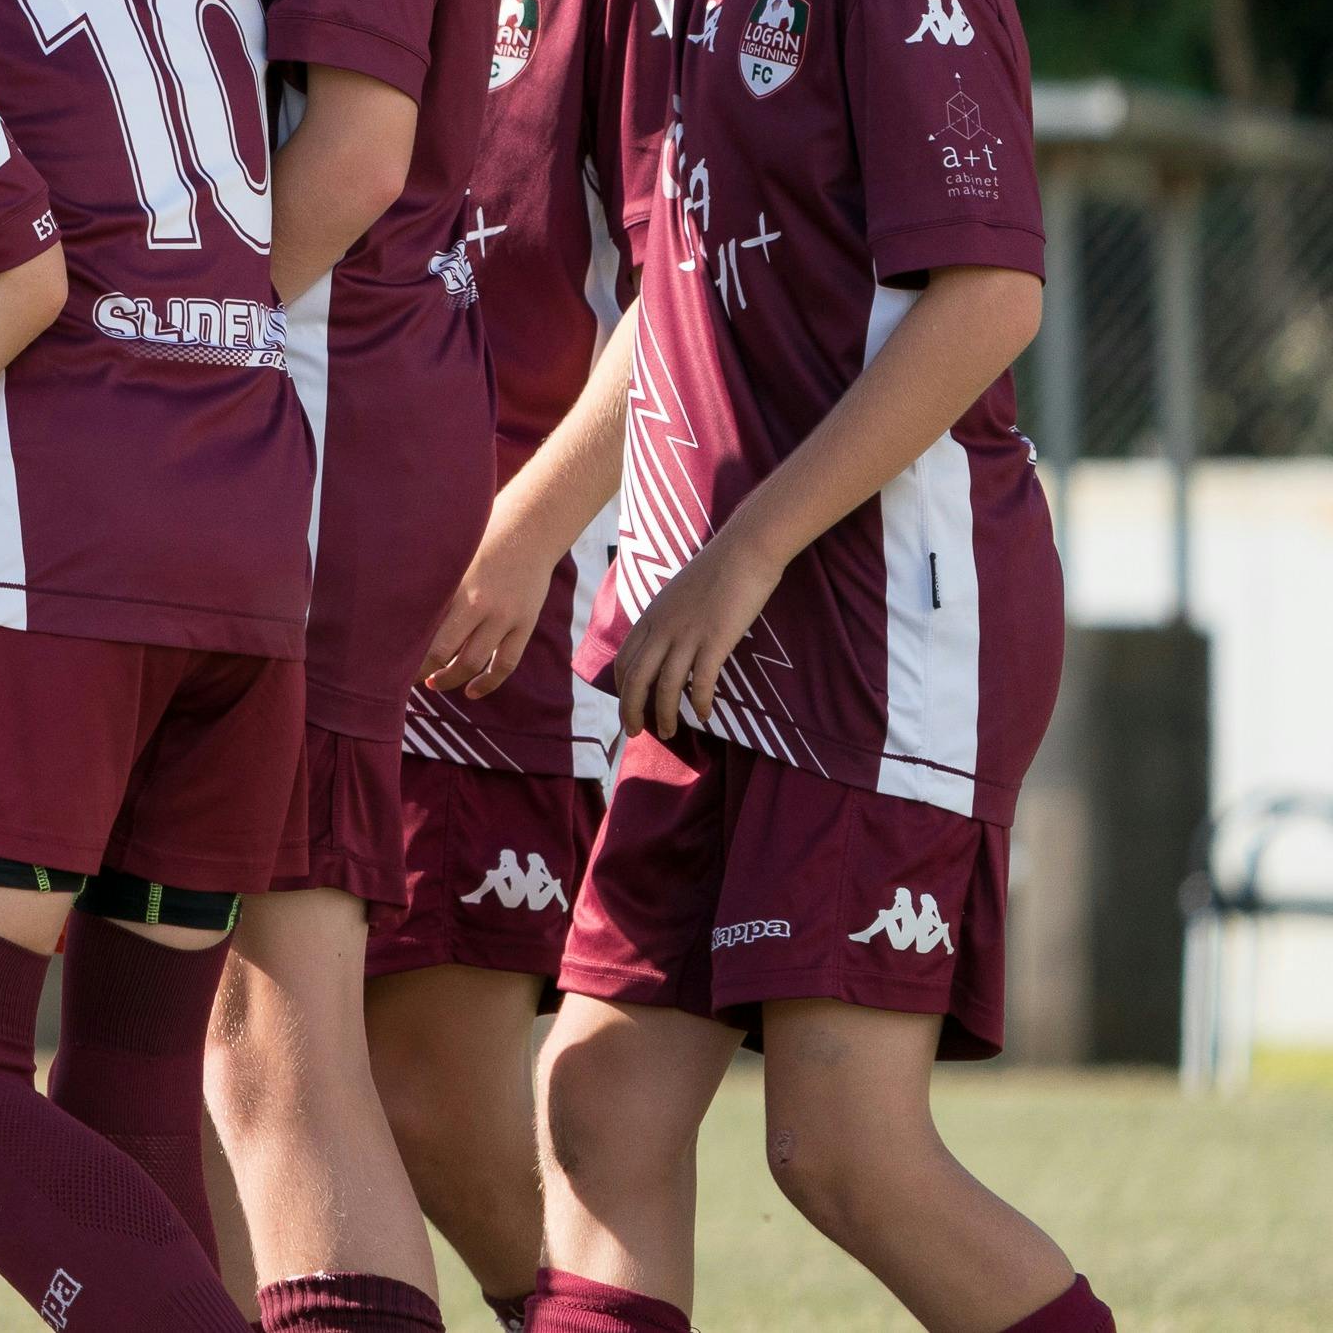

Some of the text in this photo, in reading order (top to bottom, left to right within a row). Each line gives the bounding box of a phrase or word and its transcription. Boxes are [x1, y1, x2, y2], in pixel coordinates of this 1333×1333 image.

[745, 23, 801, 53] LOGAN
[741, 41, 799, 65] LIGHTNING
[752, 63, 774, 84] FC
[945, 172, 1000, 187] cabinet
[947, 185, 1000, 200] makers
